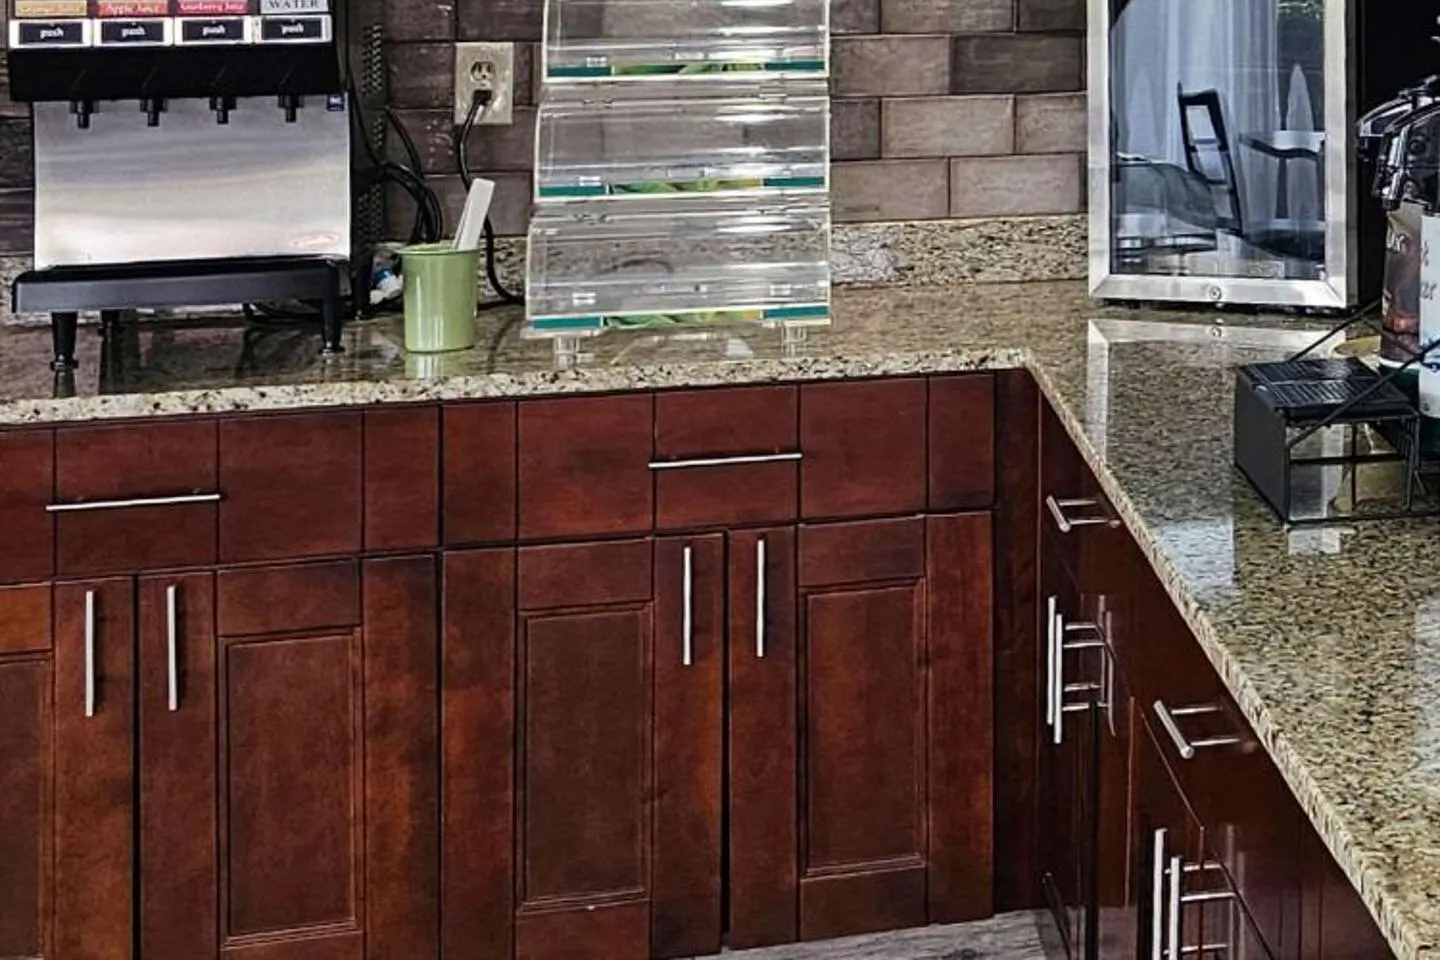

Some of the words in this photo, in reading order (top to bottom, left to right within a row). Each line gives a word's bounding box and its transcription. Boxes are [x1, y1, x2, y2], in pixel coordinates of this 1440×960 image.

[268, 0, 319, 9] WATER
[40, 27, 64, 39] push
[121, 25, 146, 38] push
[202, 24, 226, 37] push
[281, 23, 305, 35] push
